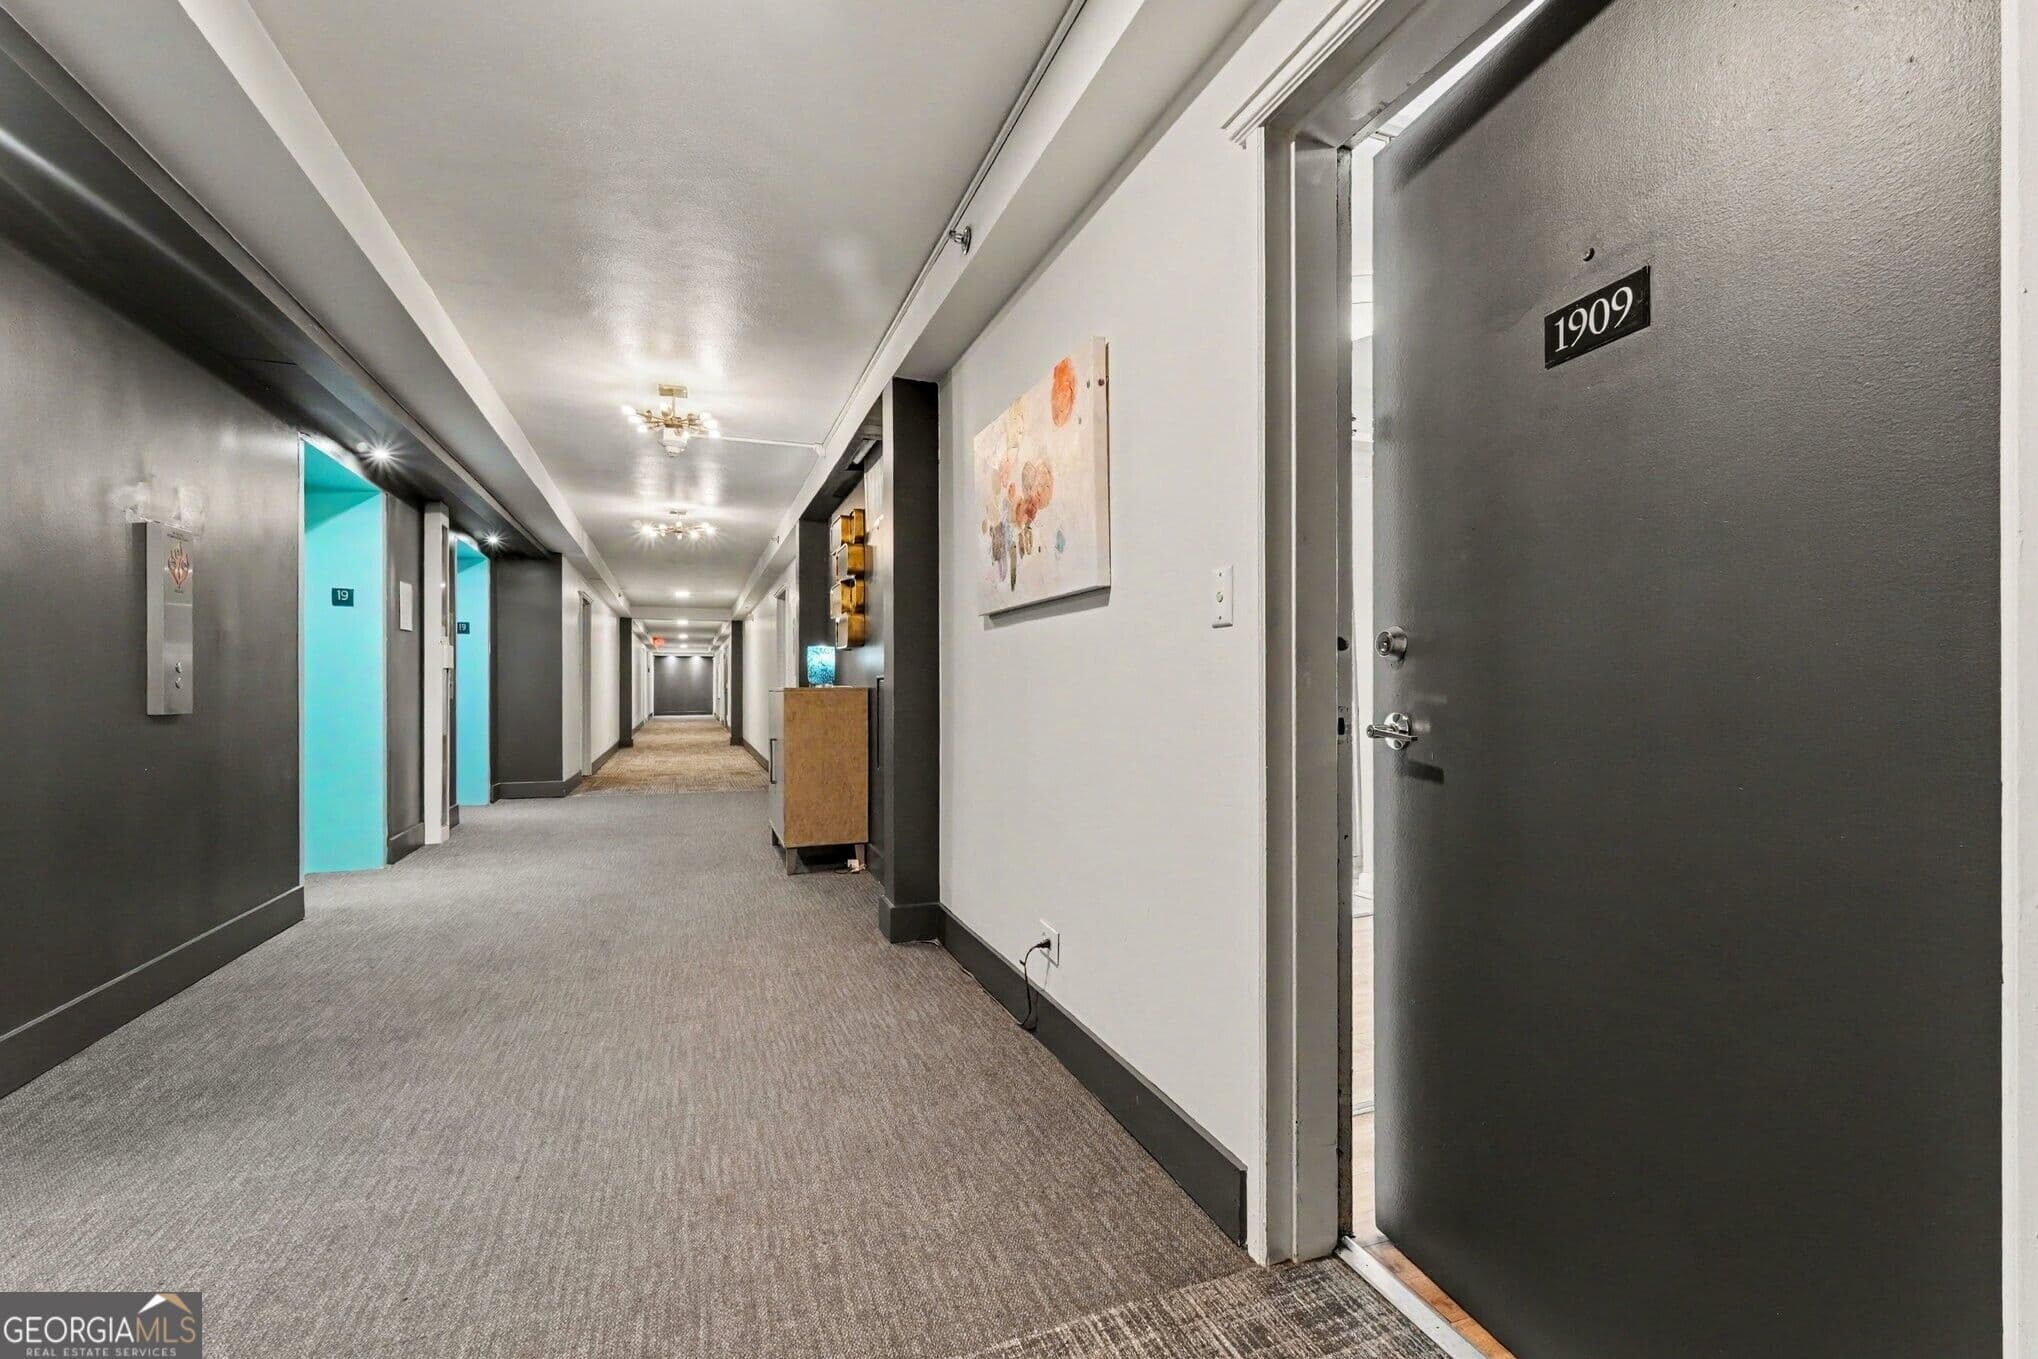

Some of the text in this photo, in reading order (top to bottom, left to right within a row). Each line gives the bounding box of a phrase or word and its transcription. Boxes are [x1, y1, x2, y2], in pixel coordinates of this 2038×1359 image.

[1554, 286, 1634, 353] 1909
[336, 589, 349, 601] 19
[458, 623, 467, 631] 19
